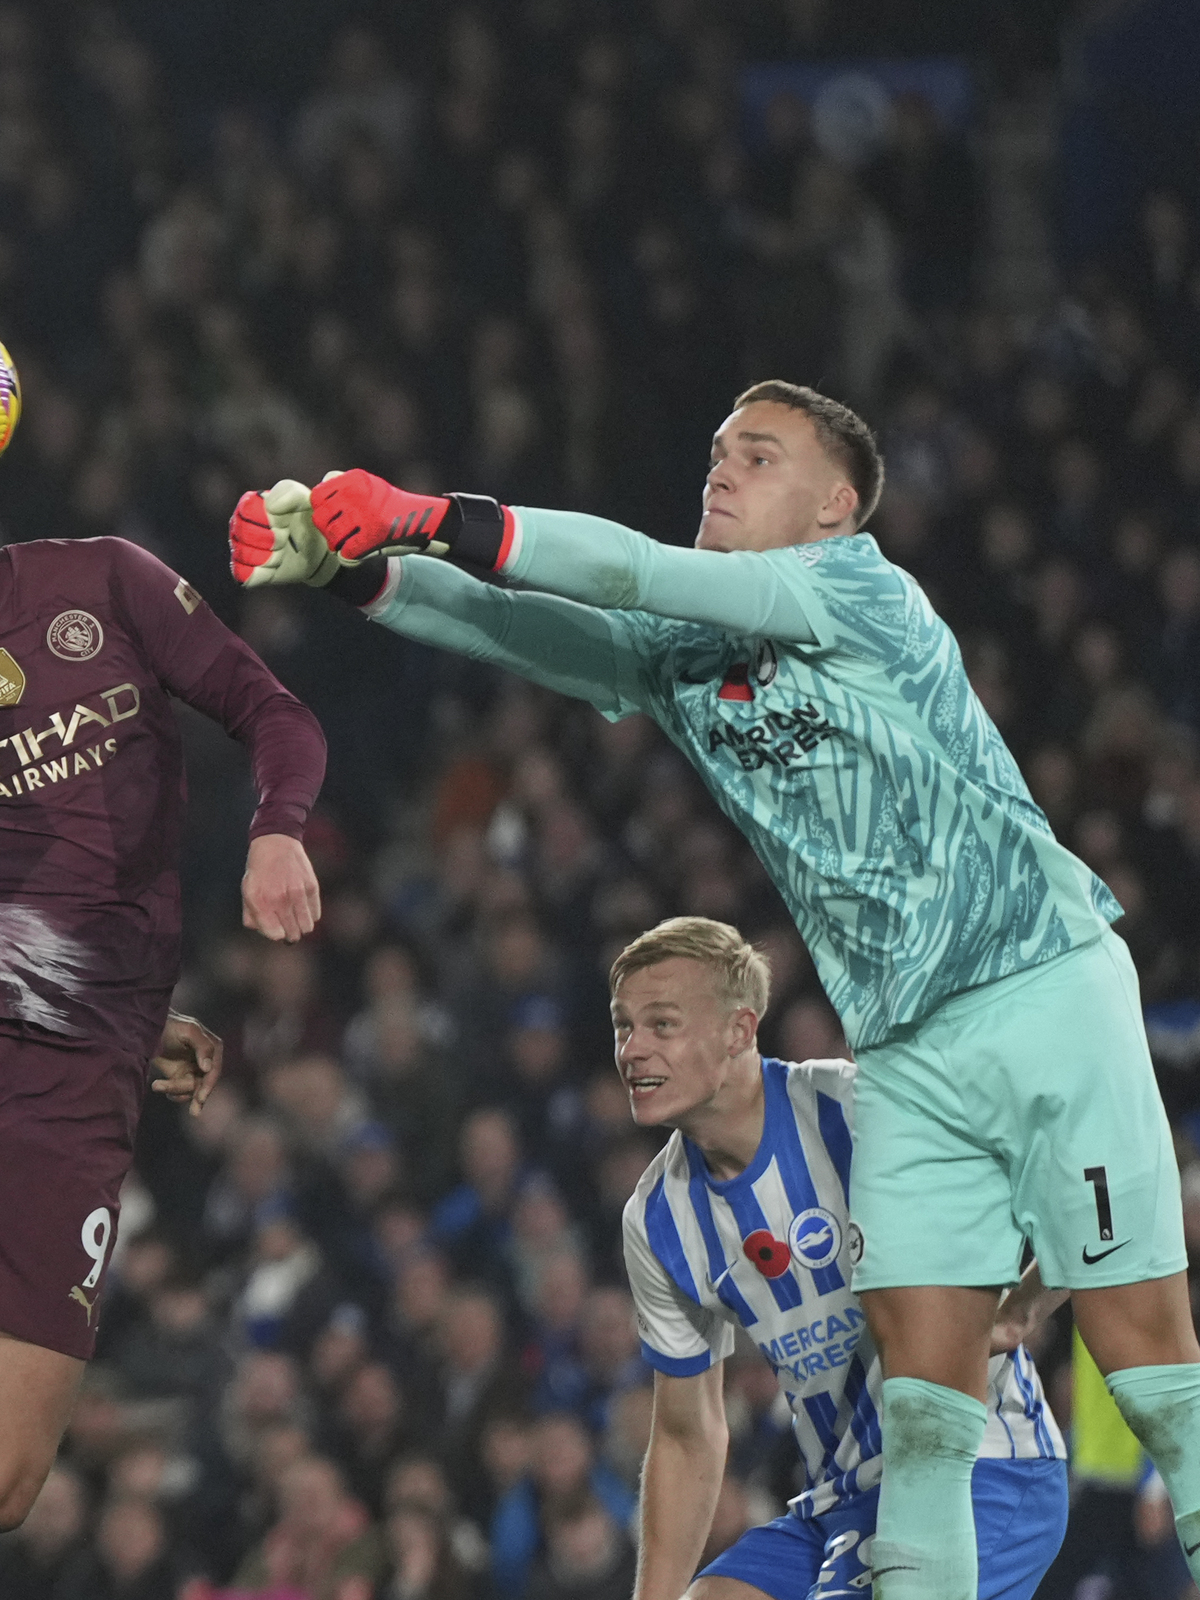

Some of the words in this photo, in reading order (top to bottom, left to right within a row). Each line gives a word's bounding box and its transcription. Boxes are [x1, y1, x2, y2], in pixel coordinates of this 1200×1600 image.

[51, 614, 88, 643] MANCHESTER
[80, 646, 95, 657] CITY
[1083, 1166, 1113, 1241] 1
[81, 1206, 111, 1288] 9
